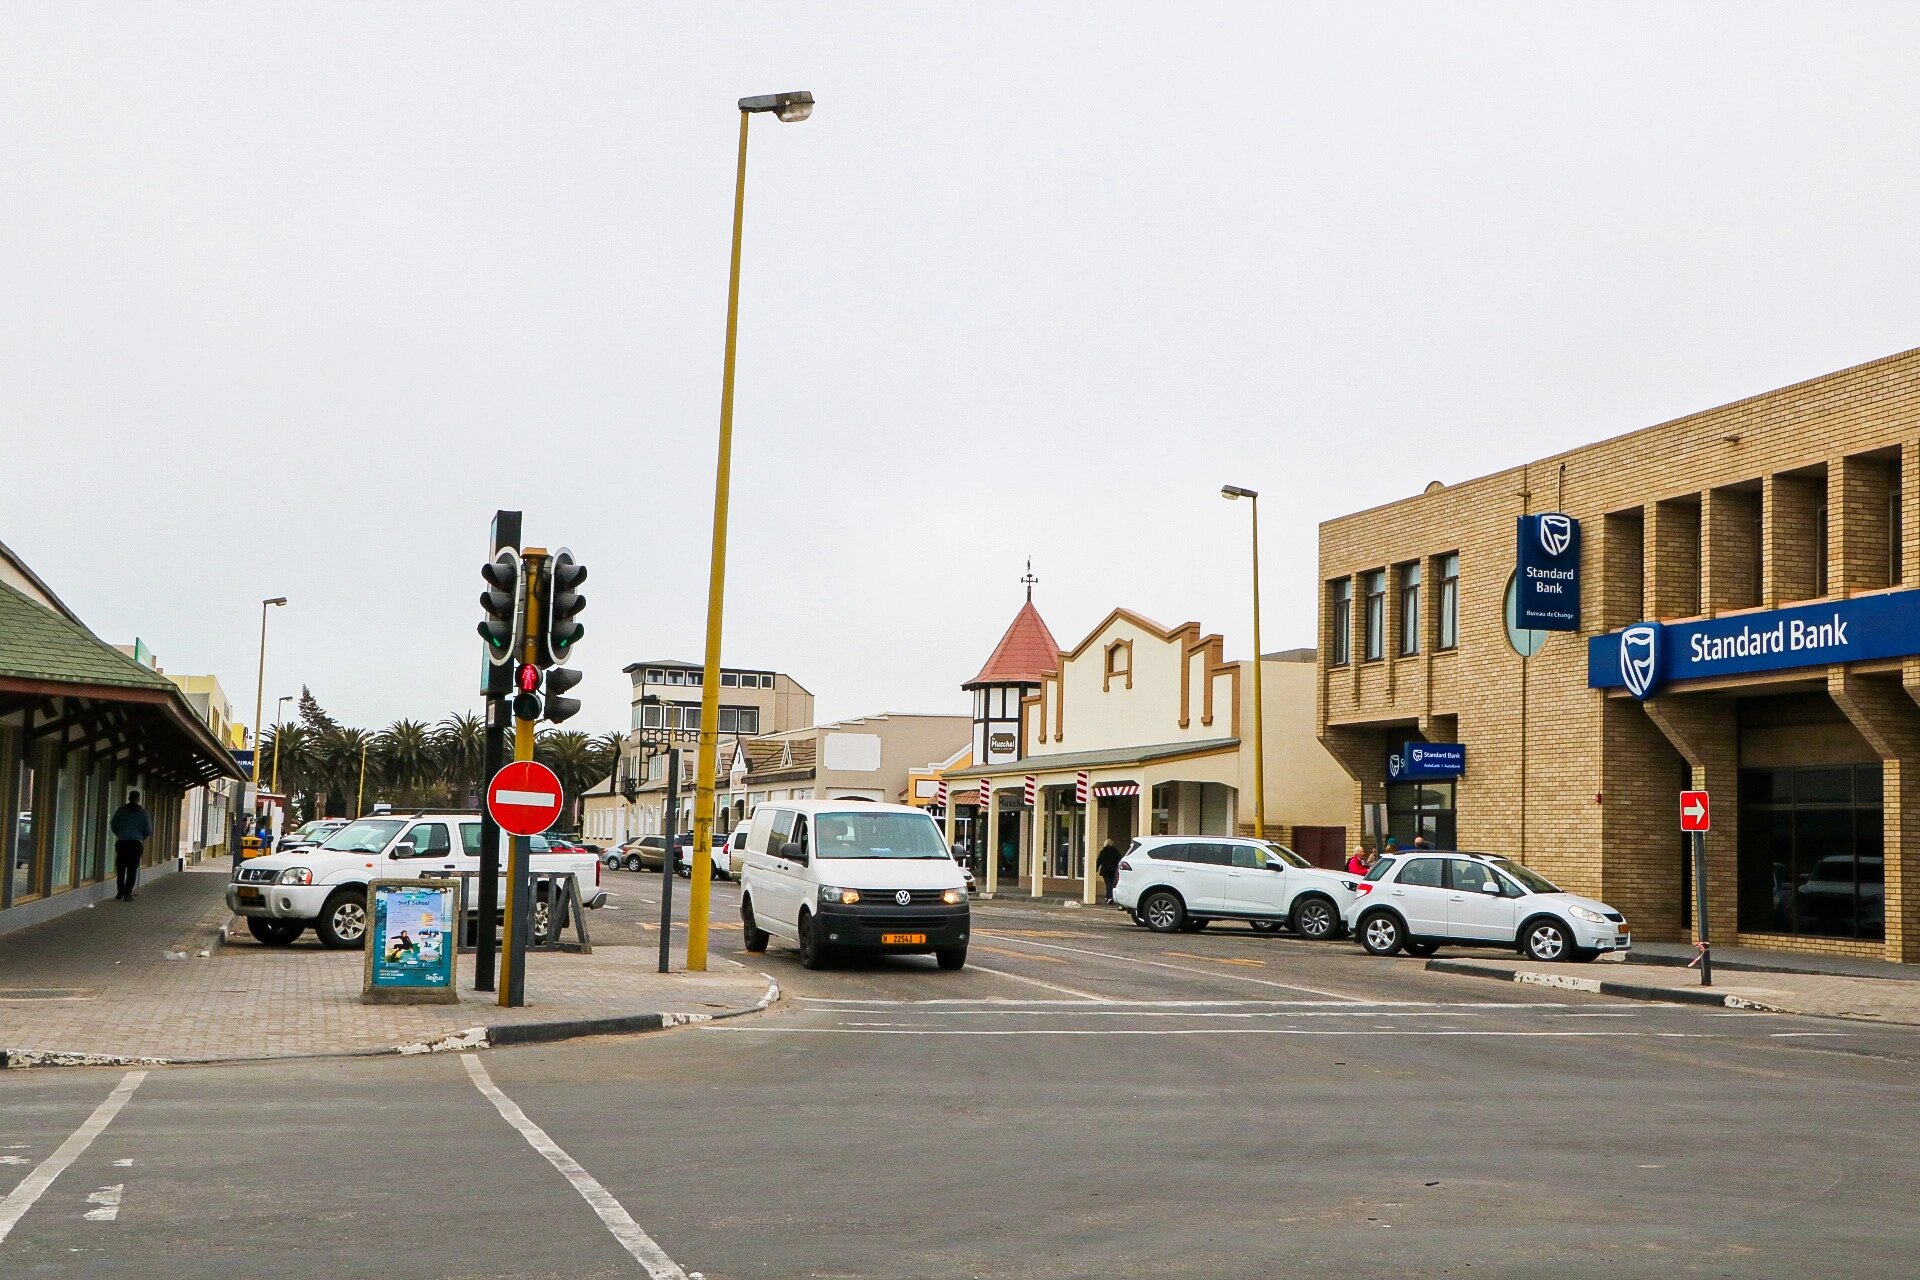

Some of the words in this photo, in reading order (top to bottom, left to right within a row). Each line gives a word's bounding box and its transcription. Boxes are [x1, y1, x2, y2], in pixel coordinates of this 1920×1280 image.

[1526, 566, 1574, 580] Standard
[1536, 581, 1563, 594] Bank
[1553, 611, 1574, 619] Change
[1690, 621, 1784, 663] Standard
[1790, 613, 1849, 651] Bank
